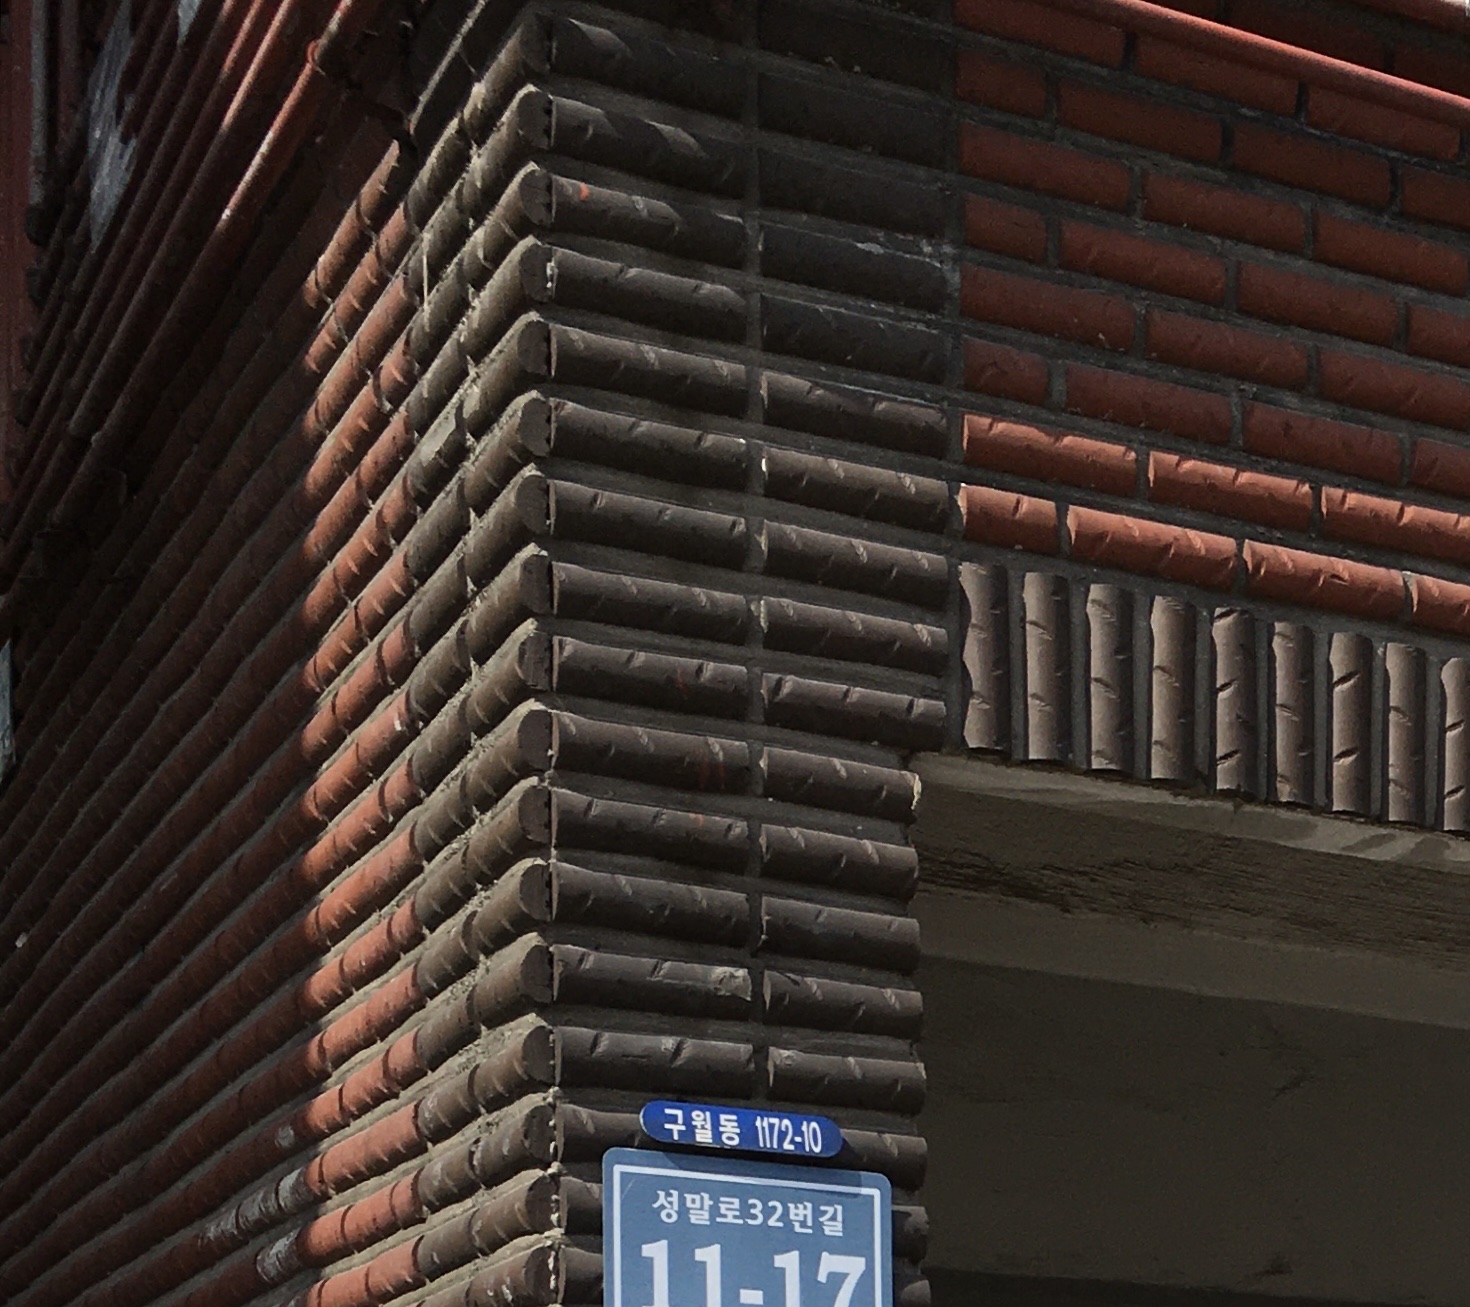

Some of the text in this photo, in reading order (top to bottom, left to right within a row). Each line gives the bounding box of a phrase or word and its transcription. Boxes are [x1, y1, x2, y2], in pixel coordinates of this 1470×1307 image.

[664, 1108, 822, 1153] 구월동 1172-10
[652, 1189, 843, 1237] 성말로32번길
